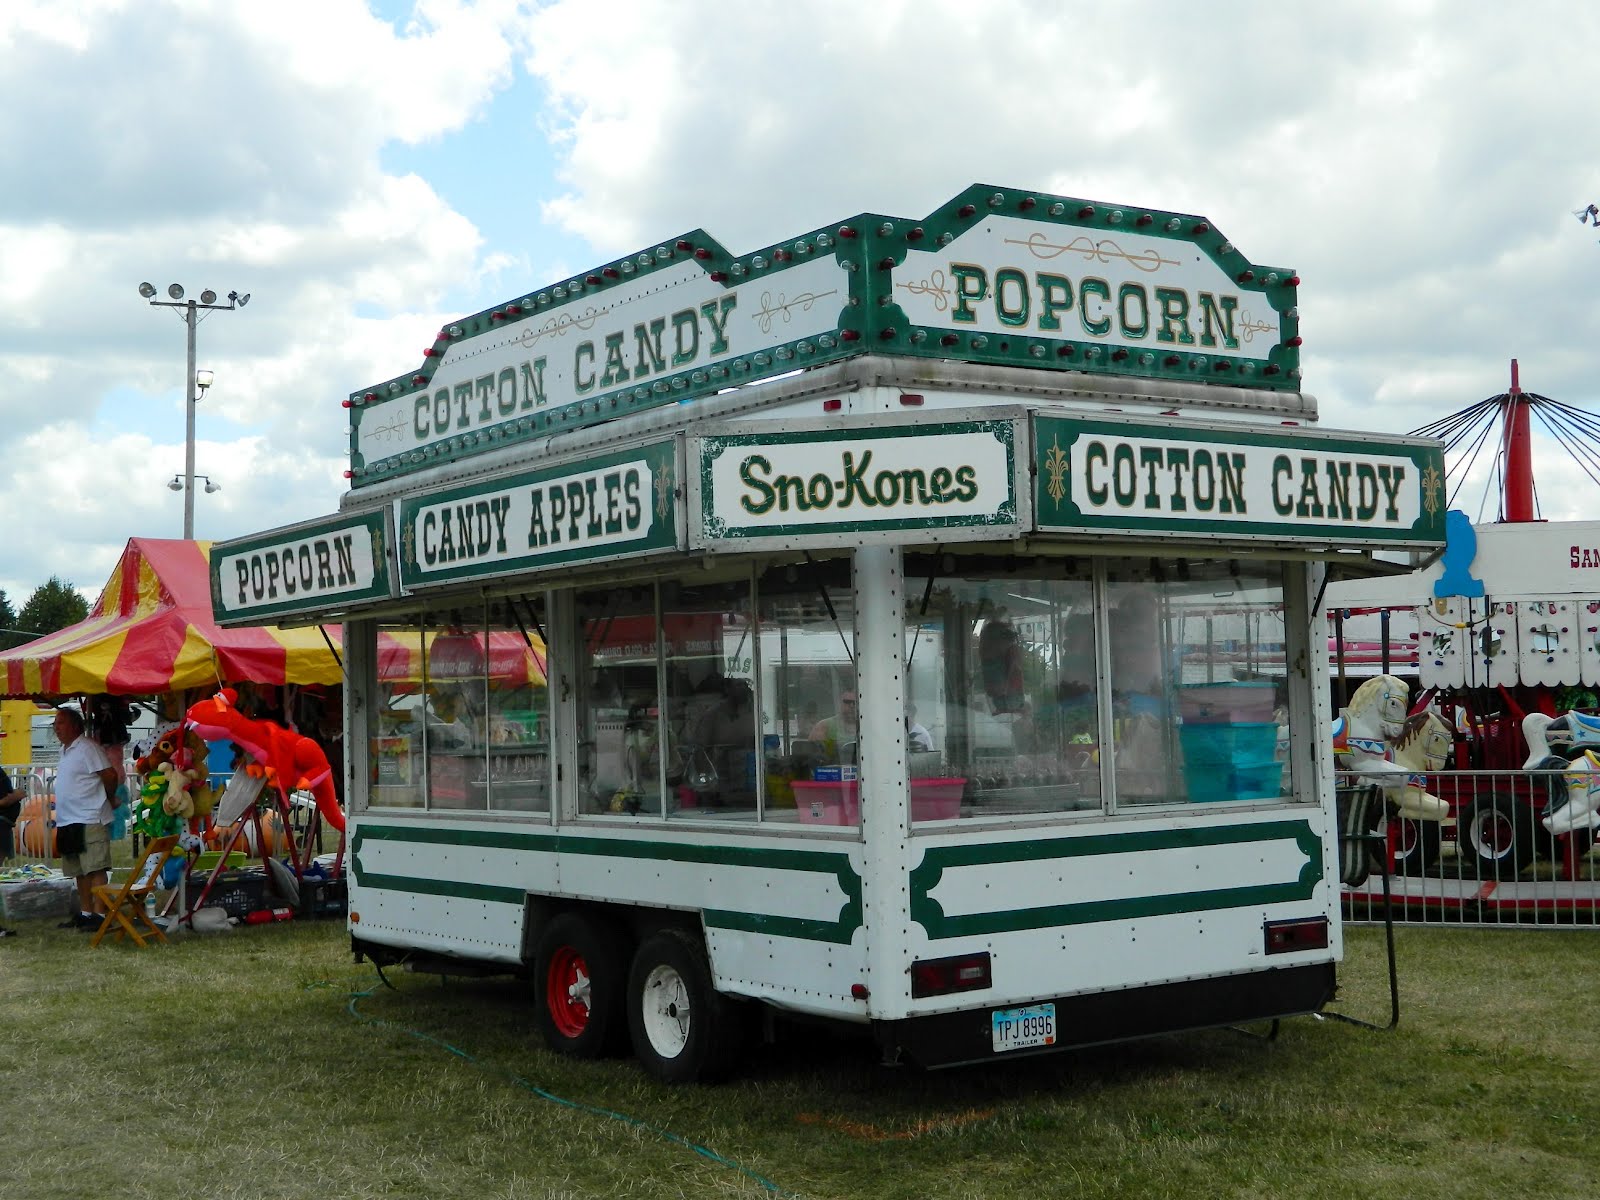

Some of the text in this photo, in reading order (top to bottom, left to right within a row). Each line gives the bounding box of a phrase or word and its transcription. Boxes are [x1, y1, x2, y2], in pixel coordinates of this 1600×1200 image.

[949, 262, 1240, 351] POPCORN
[413, 291, 738, 441] COTTON CANDY
[423, 468, 642, 567] CANDY APPLES
[739, 449, 979, 516] Sno-Kones
[1085, 440, 1406, 523] COTTON CANDY
[235, 533, 357, 605] POPCORN
[997, 1015, 1052, 1041] TPJ 8996
[1013, 1038, 1038, 1047] TRAILER
